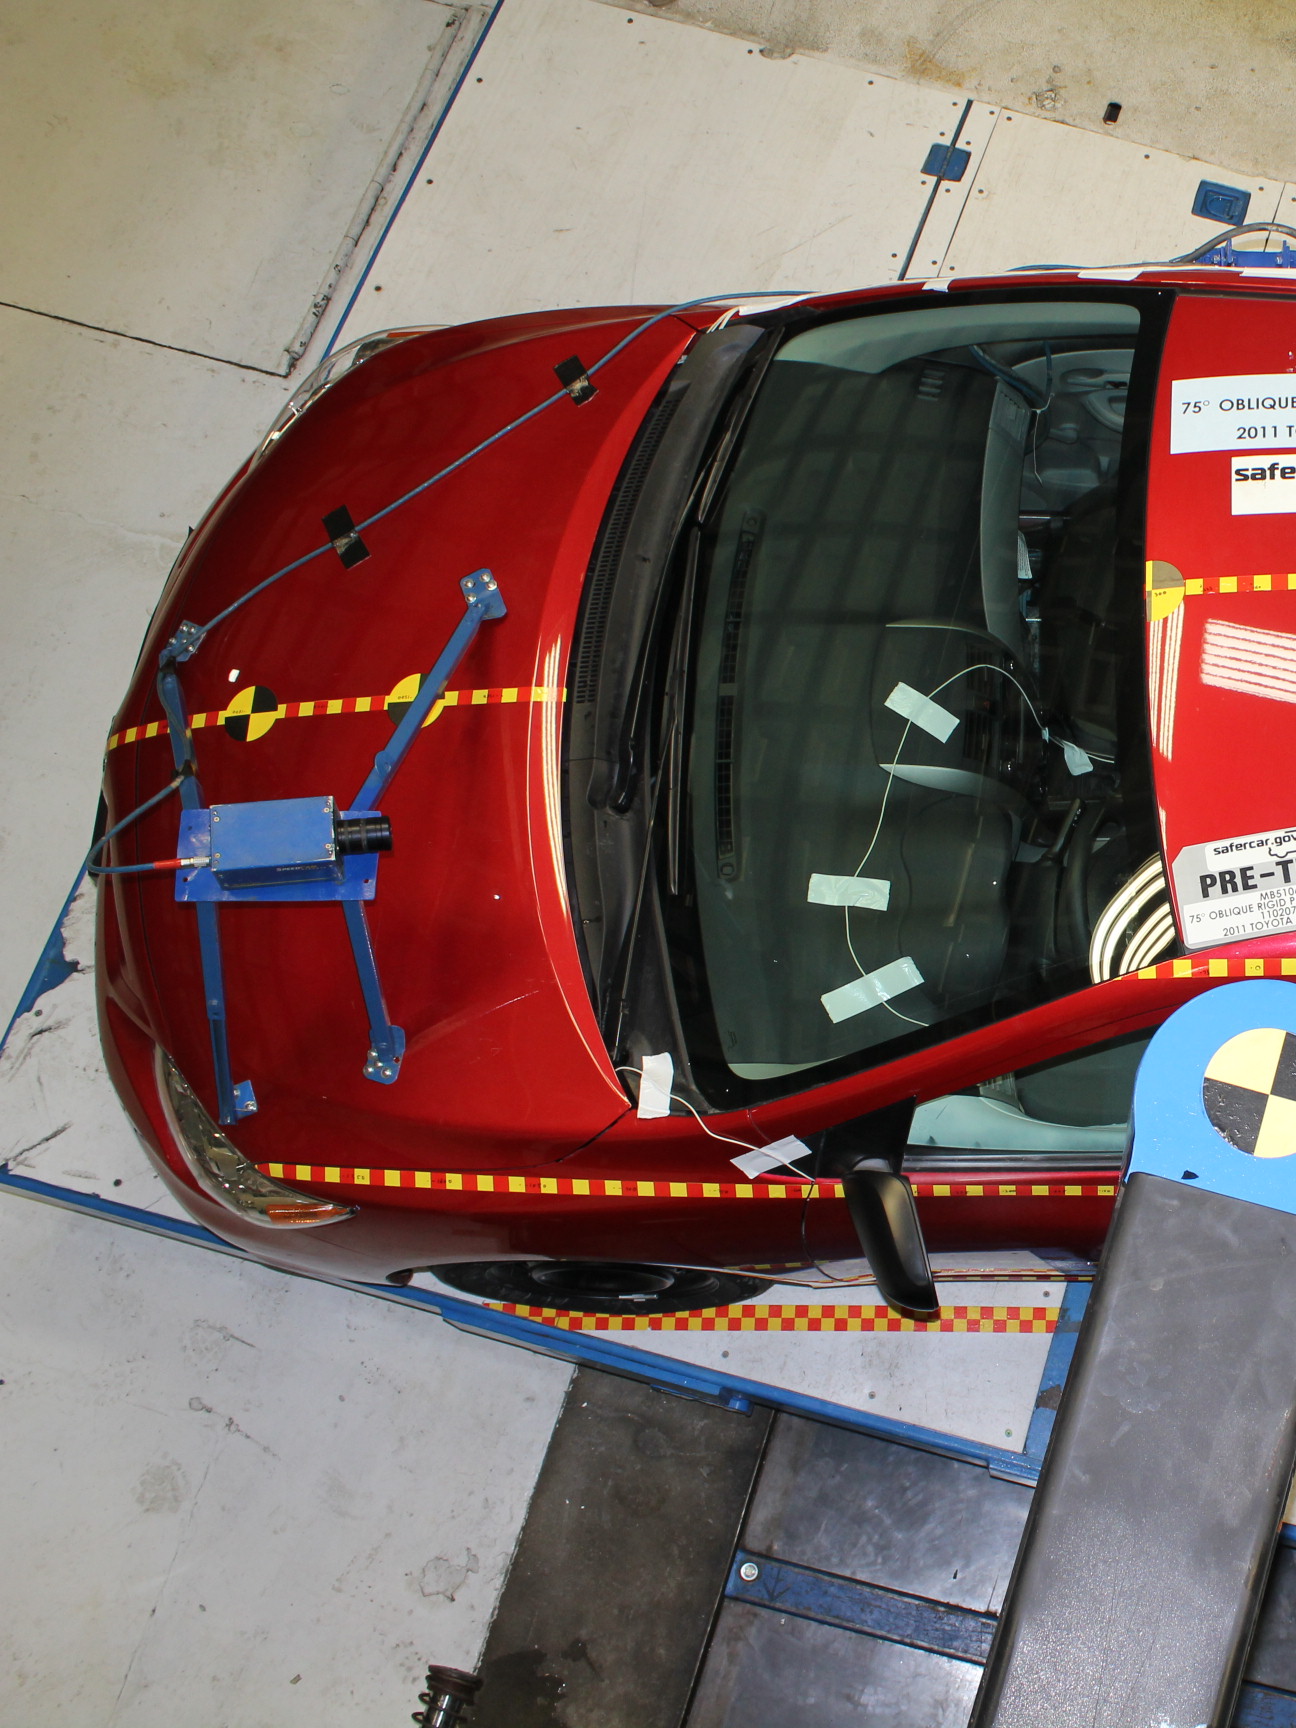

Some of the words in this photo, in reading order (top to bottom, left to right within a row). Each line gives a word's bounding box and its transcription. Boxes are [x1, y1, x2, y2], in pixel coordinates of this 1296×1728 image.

[1181, 400, 1211, 415] 75°
[1236, 425, 1279, 440] 2011
[1209, 904, 1254, 921] OBLIQUE
[1257, 898, 1287, 911] RIGID
[1222, 924, 1247, 937] 2011
[1250, 914, 1293, 932] TOYOTA
